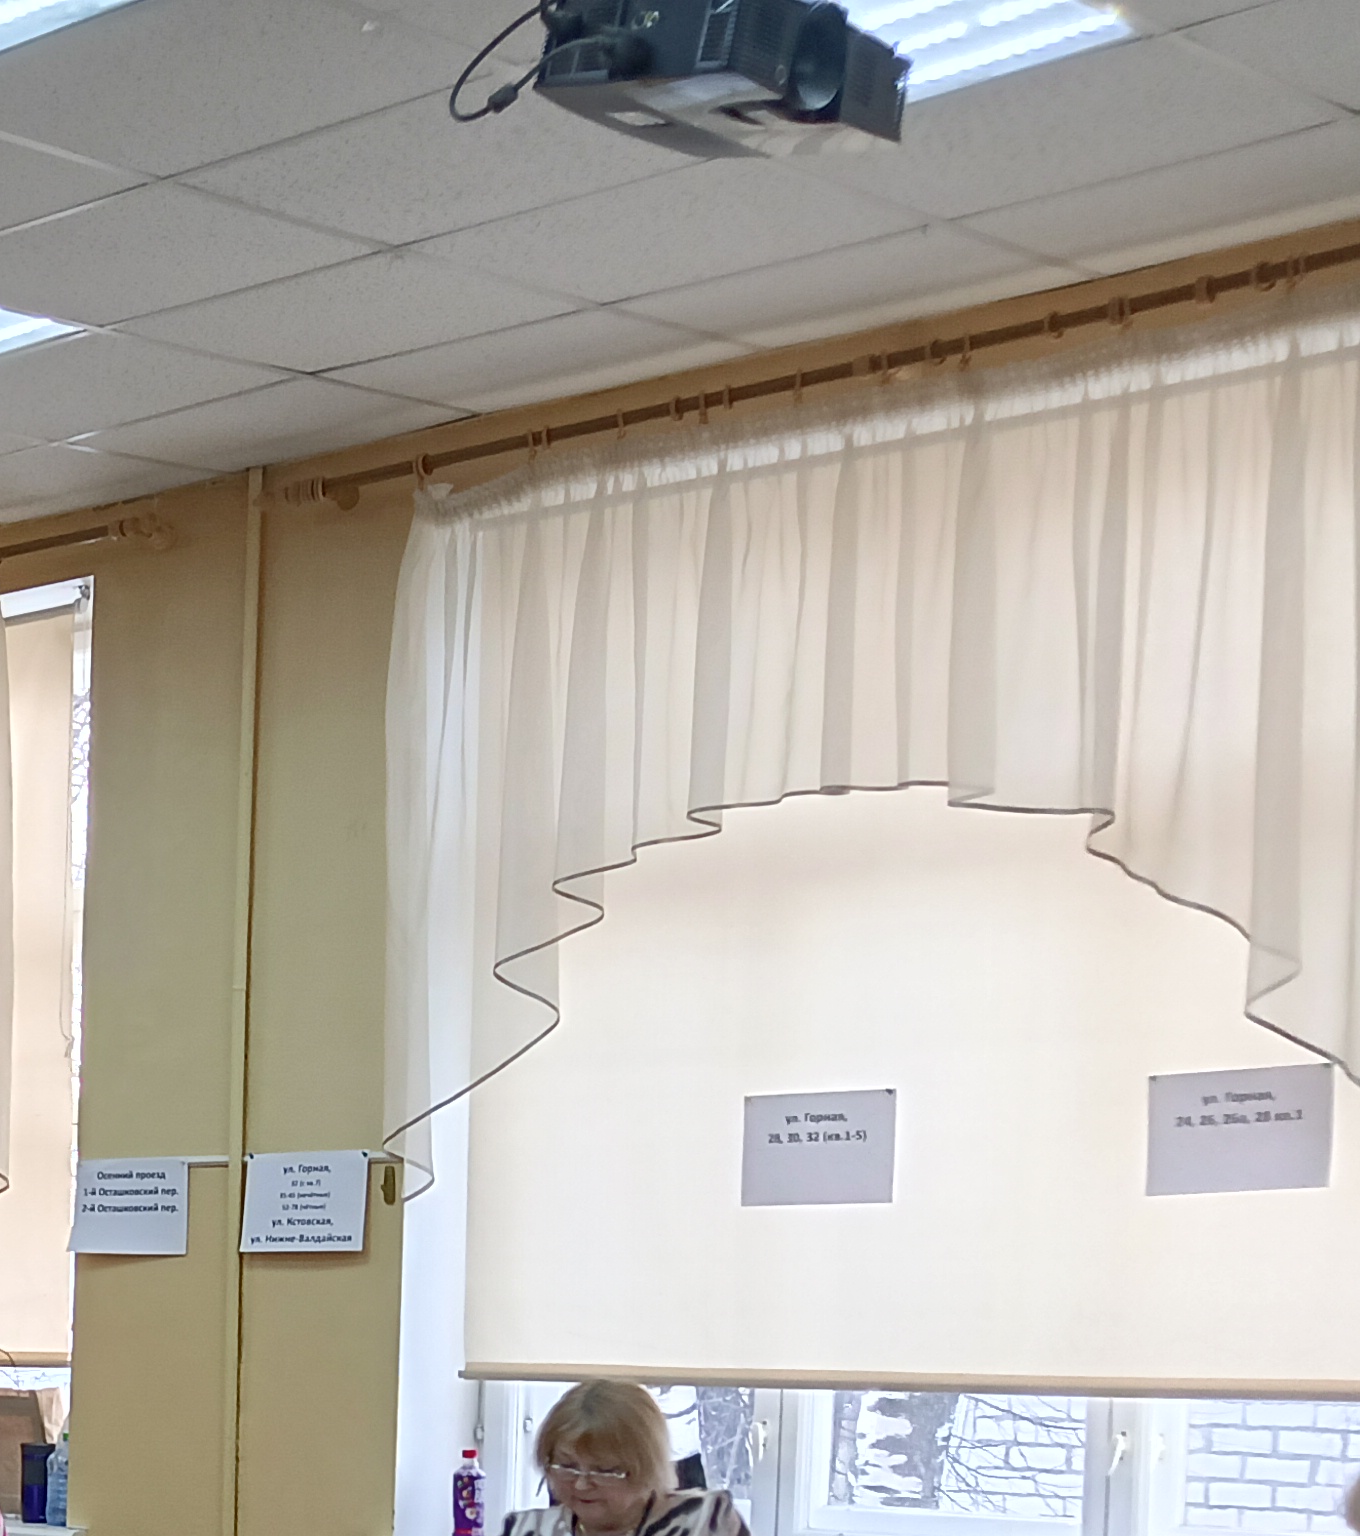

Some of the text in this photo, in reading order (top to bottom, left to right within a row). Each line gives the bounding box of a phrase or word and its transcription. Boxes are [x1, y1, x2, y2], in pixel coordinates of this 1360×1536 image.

[785, 1113, 848, 1125] ул. Горная,
[806, 1132, 819, 1142] 32
[283, 1165, 331, 1175] ул. Горная,
[97, 1170, 166, 1181] Осенний проезд
[84, 1187, 179, 1196] 1-й Осташковский пер.
[82, 1204, 178, 1213] 2-й Осташковский пер.
[272, 1218, 333, 1228] ул. Кстовская,
[251, 1233, 352, 1245] ул. Нижне-Валдайская
